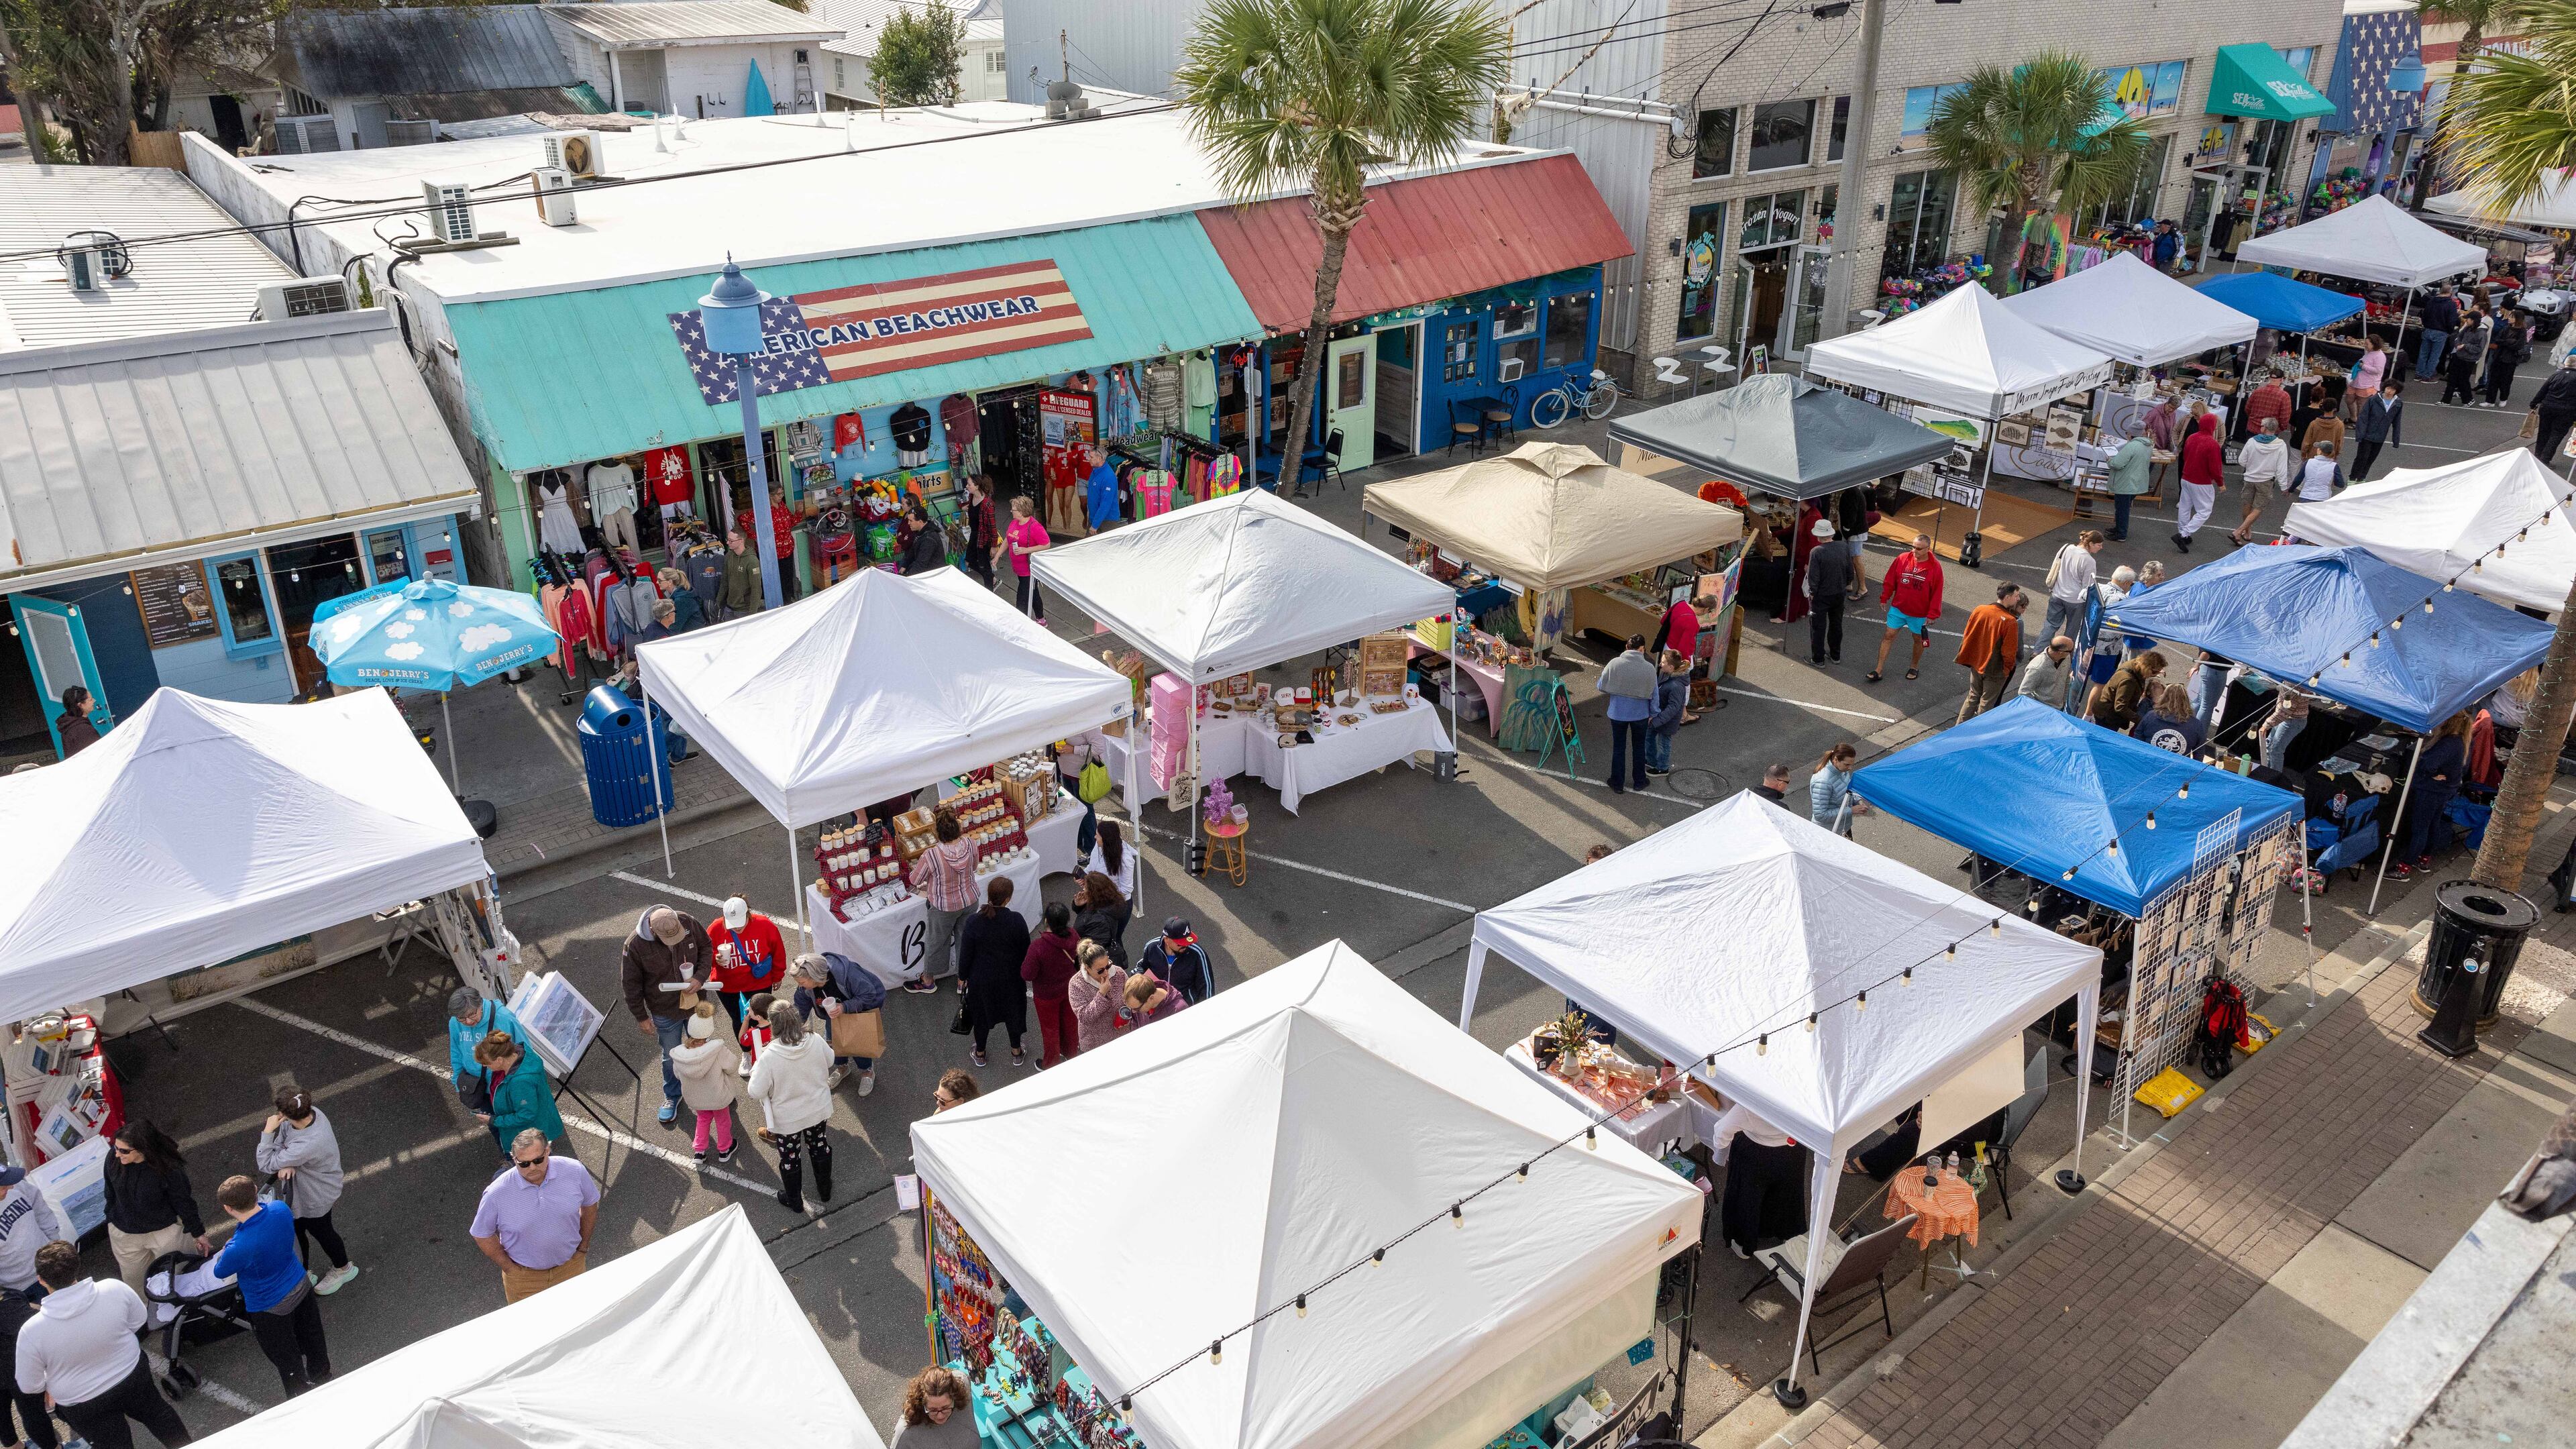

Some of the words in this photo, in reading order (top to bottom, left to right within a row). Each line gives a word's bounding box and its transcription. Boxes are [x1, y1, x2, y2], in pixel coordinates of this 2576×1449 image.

[1740, 209, 1767, 235] Frozen
[1773, 208, 1801, 225] Yogurt
[719, 321, 873, 364] ERICAN
[873, 295, 1040, 337] BEACHWEAR
[2015, 391, 2039, 410] Mirror
[2039, 384, 2057, 401] Image
[2074, 370, 2100, 390] Printing
[1040, 404, 1057, 412] OFFICIAL
[1076, 407, 1091, 417] DEALER
[916, 476, 941, 489] hirts
[378, 566, 405, 577] OPEN
[188, 619, 213, 627] SHAKES
[476, 658, 494, 672] BEN
[498, 644, 534, 662] JERRY'S
[358, 668, 381, 677] BEN
[388, 669, 430, 680] JERRY'S
[1617, 1396, 1648, 1442] WAY
